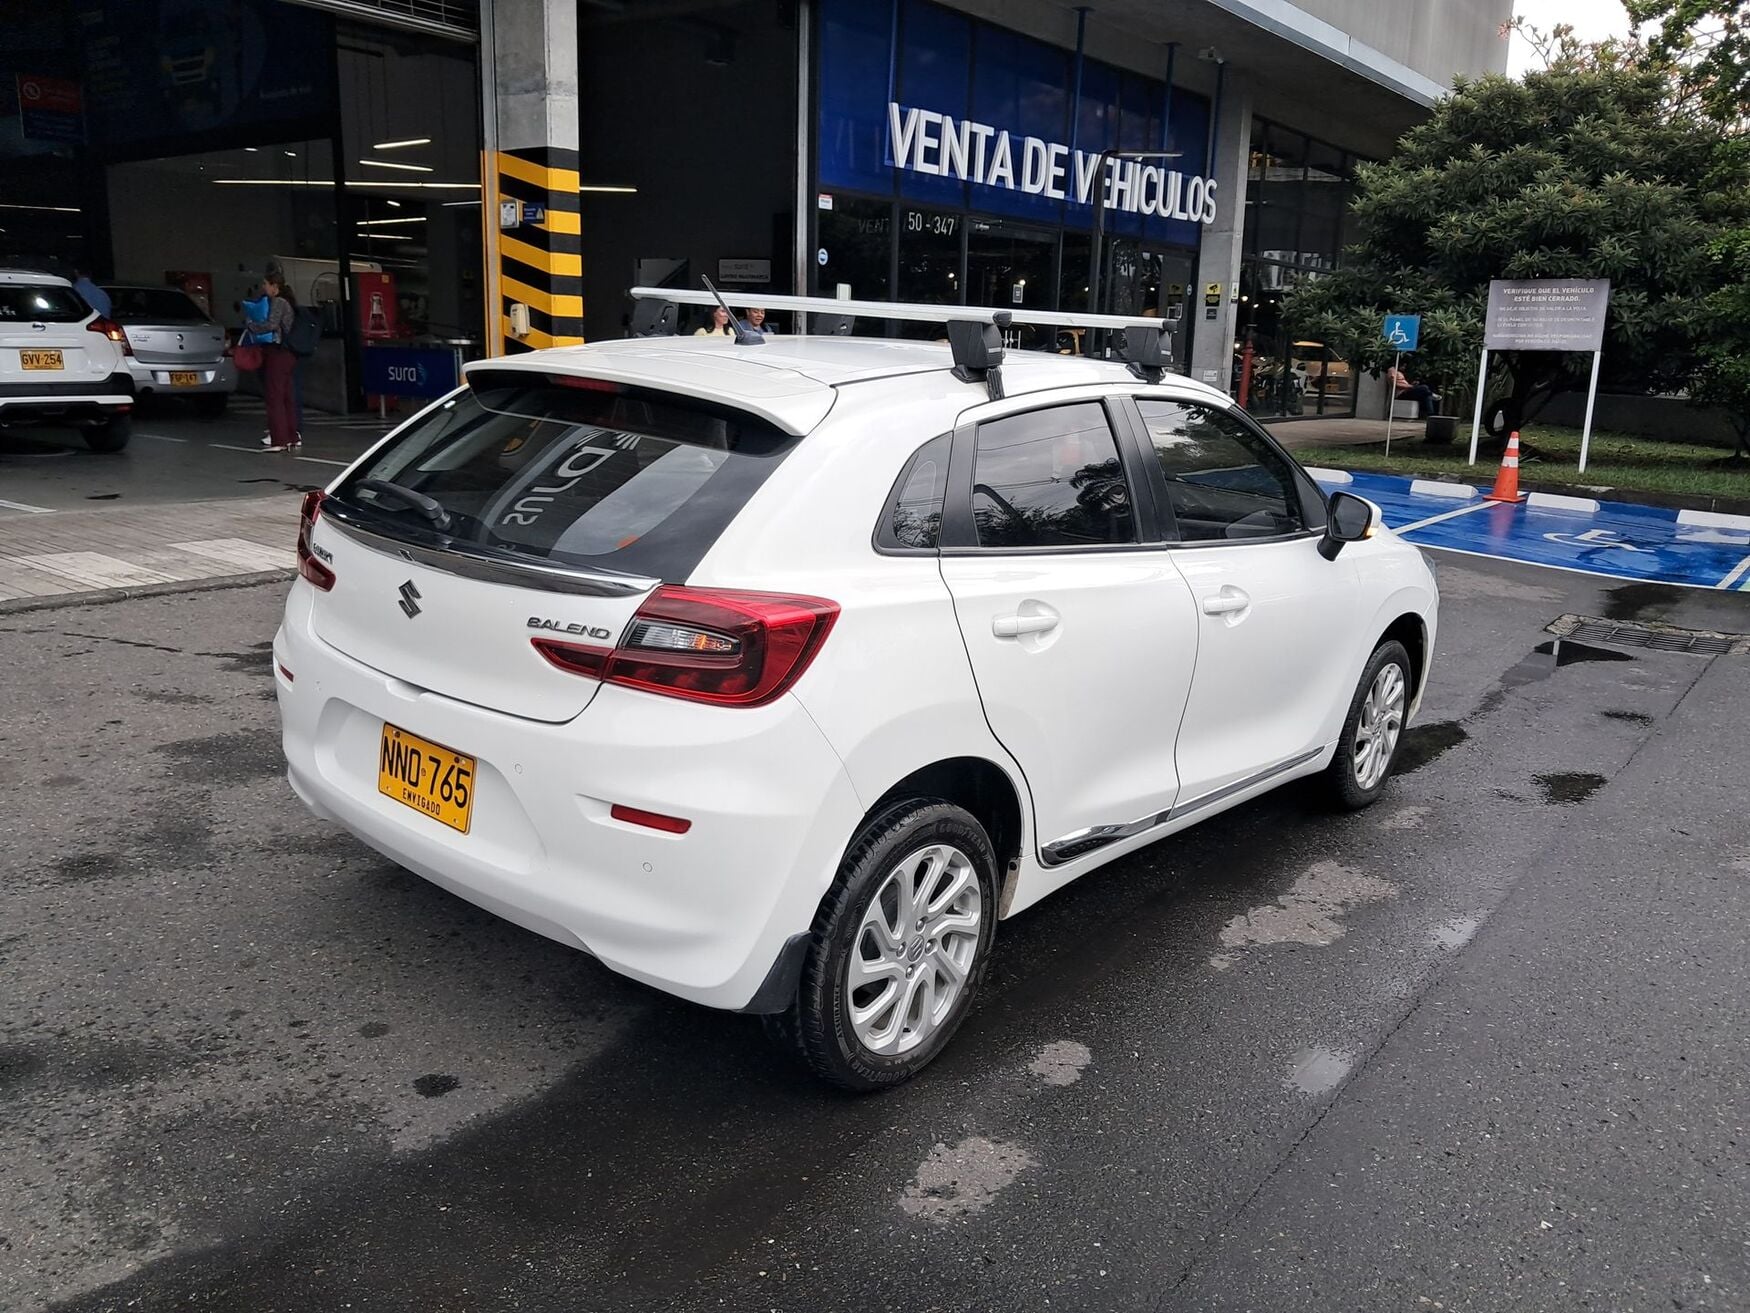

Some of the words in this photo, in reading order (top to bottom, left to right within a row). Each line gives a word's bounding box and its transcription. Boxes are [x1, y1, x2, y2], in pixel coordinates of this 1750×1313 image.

[888, 102, 1015, 189] VENTA
[1021, 136, 1069, 199] DE
[908, 212, 923, 231] 50
[934, 216, 955, 236] 347
[22, 353, 40, 365] GVV
[43, 353, 62, 365] 254
[388, 366, 417, 382] sura
[527, 616, 611, 640] BALENO
[382, 735, 421, 788] NNO
[428, 755, 471, 809] 765
[402, 787, 441, 816] ENVIGADO
